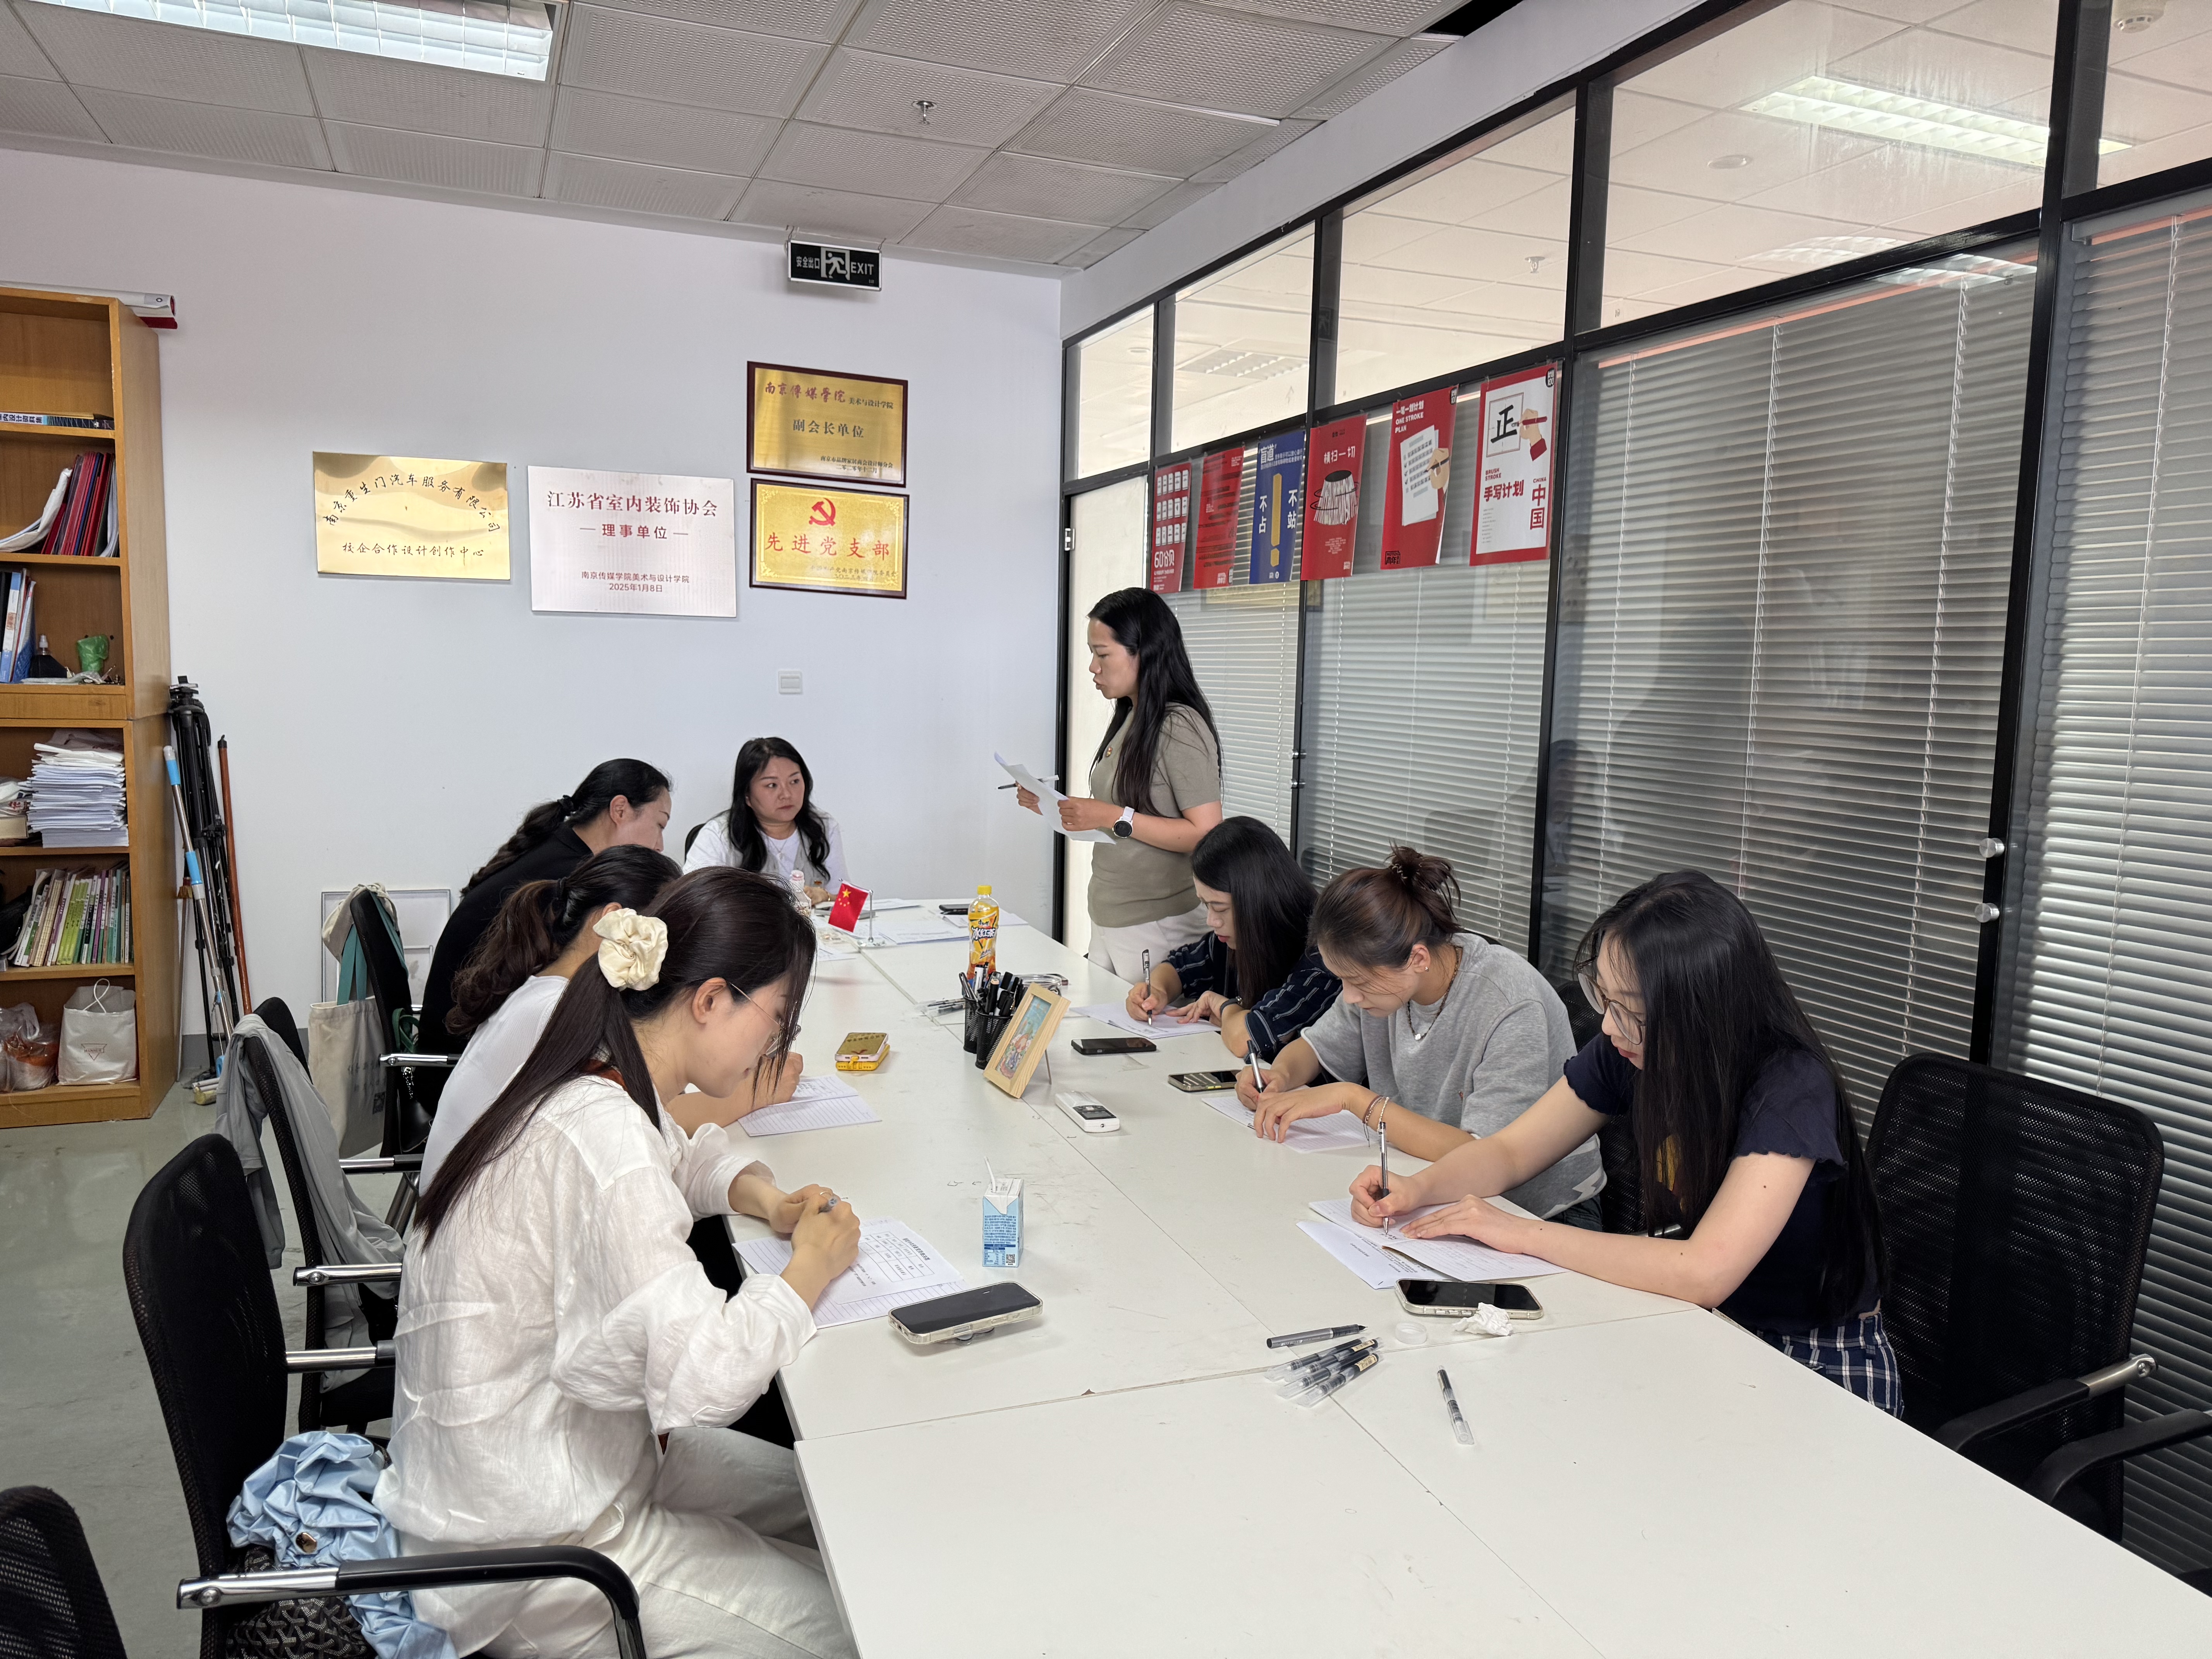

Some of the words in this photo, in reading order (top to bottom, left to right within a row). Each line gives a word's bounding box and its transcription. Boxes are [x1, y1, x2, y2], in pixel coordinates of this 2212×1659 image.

[796, 256, 820, 270] 安全出口
[851, 262, 874, 275] EXIT
[1396, 417, 1405, 425] ONE
[1405, 412, 1424, 422] STROKE
[1491, 404, 1517, 443] 正
[793, 419, 864, 438] 副会长单位
[1395, 424, 1407, 433] PLAN
[1324, 446, 1356, 465] 横扫一切
[1485, 473, 1501, 481] STROKE
[1484, 479, 1525, 502] 手写计划
[546, 490, 718, 517] 江苏省室内装饰协会
[1287, 489, 1297, 529] 不站
[1529, 483, 1546, 531] 中国
[1259, 495, 1267, 534] 不占
[342, 542, 484, 567] 校企合作设计创作中心
[765, 532, 890, 561] 先进党支部
[581, 571, 690, 583] 南京传媒学院美术与设计学院
[609, 583, 663, 593] 2025年1月8日
[971, 927, 996, 940] 冰红茶
